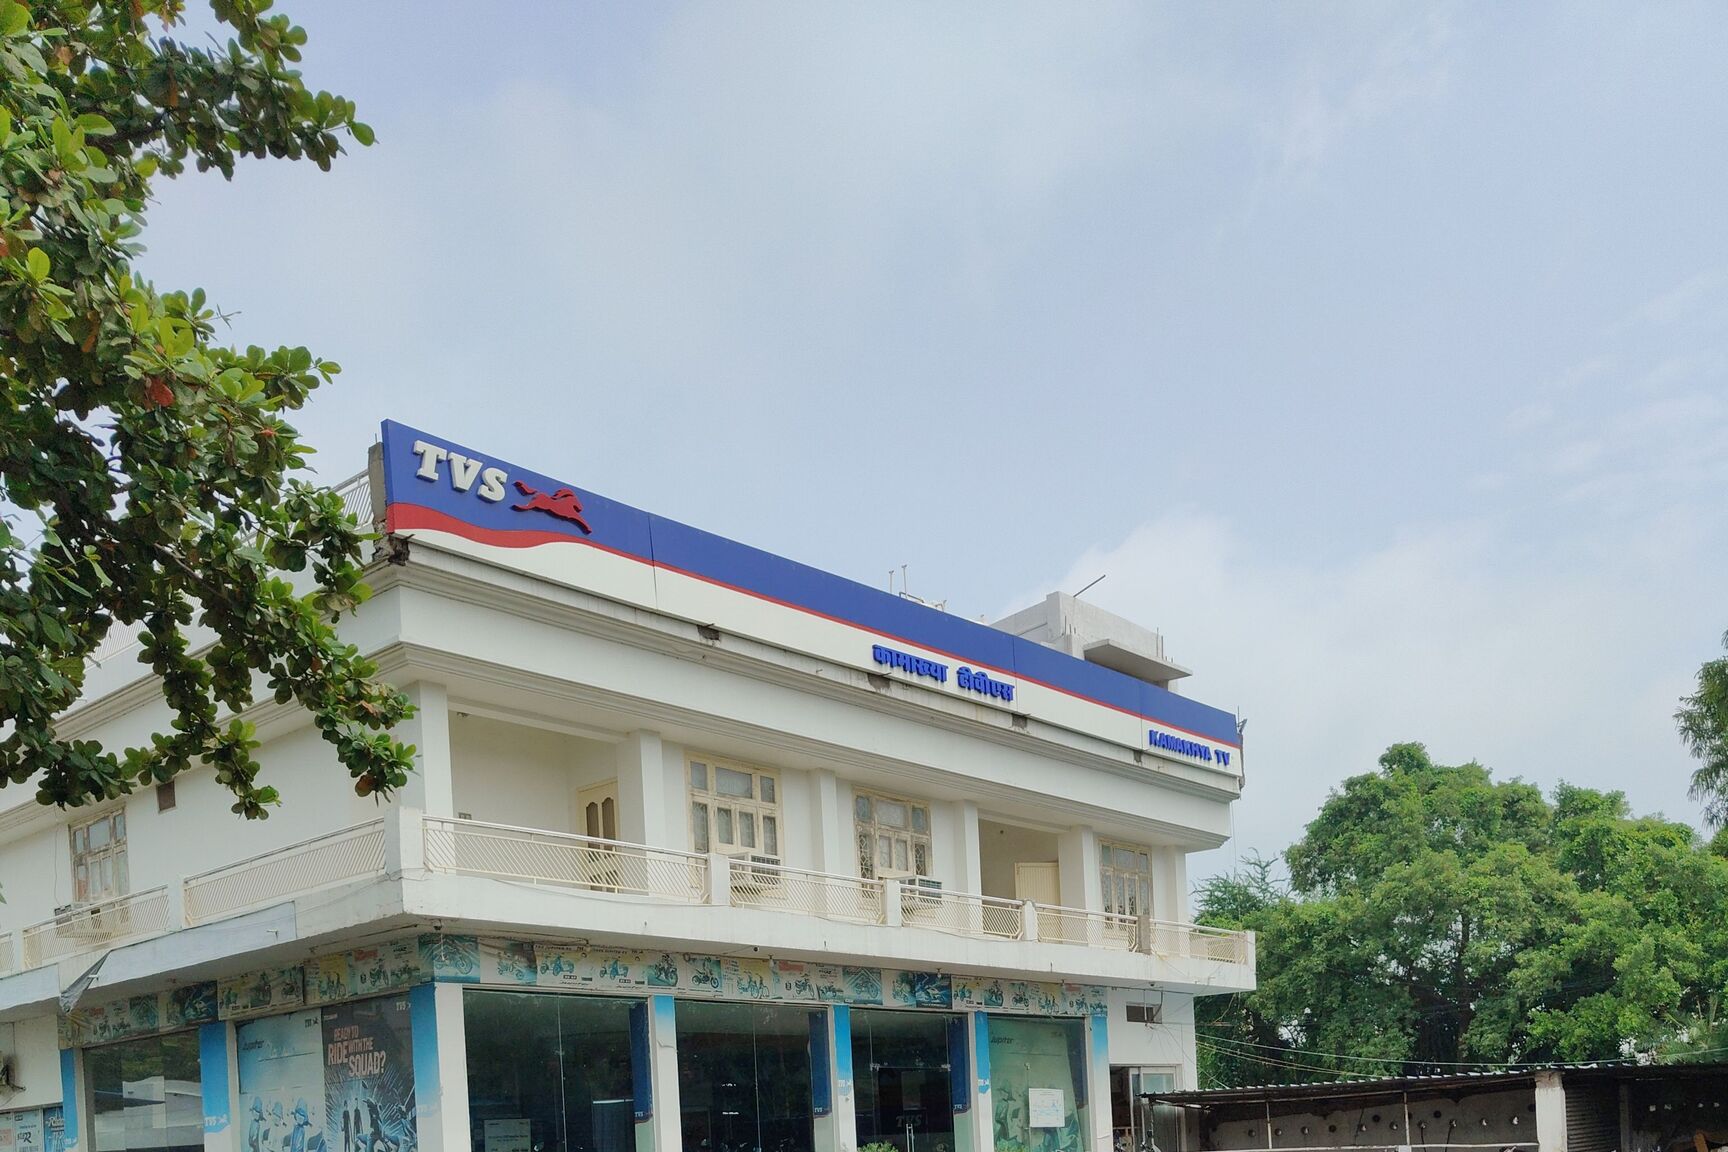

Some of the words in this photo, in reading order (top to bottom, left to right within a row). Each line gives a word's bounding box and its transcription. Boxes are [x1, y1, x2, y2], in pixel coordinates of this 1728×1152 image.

[413, 439, 508, 502] TVS
[872, 644, 949, 683] कामाख्या
[956, 666, 1015, 702] टीवीएस
[1148, 729, 1212, 761] KAMAKHYA
[1214, 749, 1230, 766] TV
[328, 1041, 349, 1066] RIDE
[349, 1050, 386, 1078] SQUAD?
